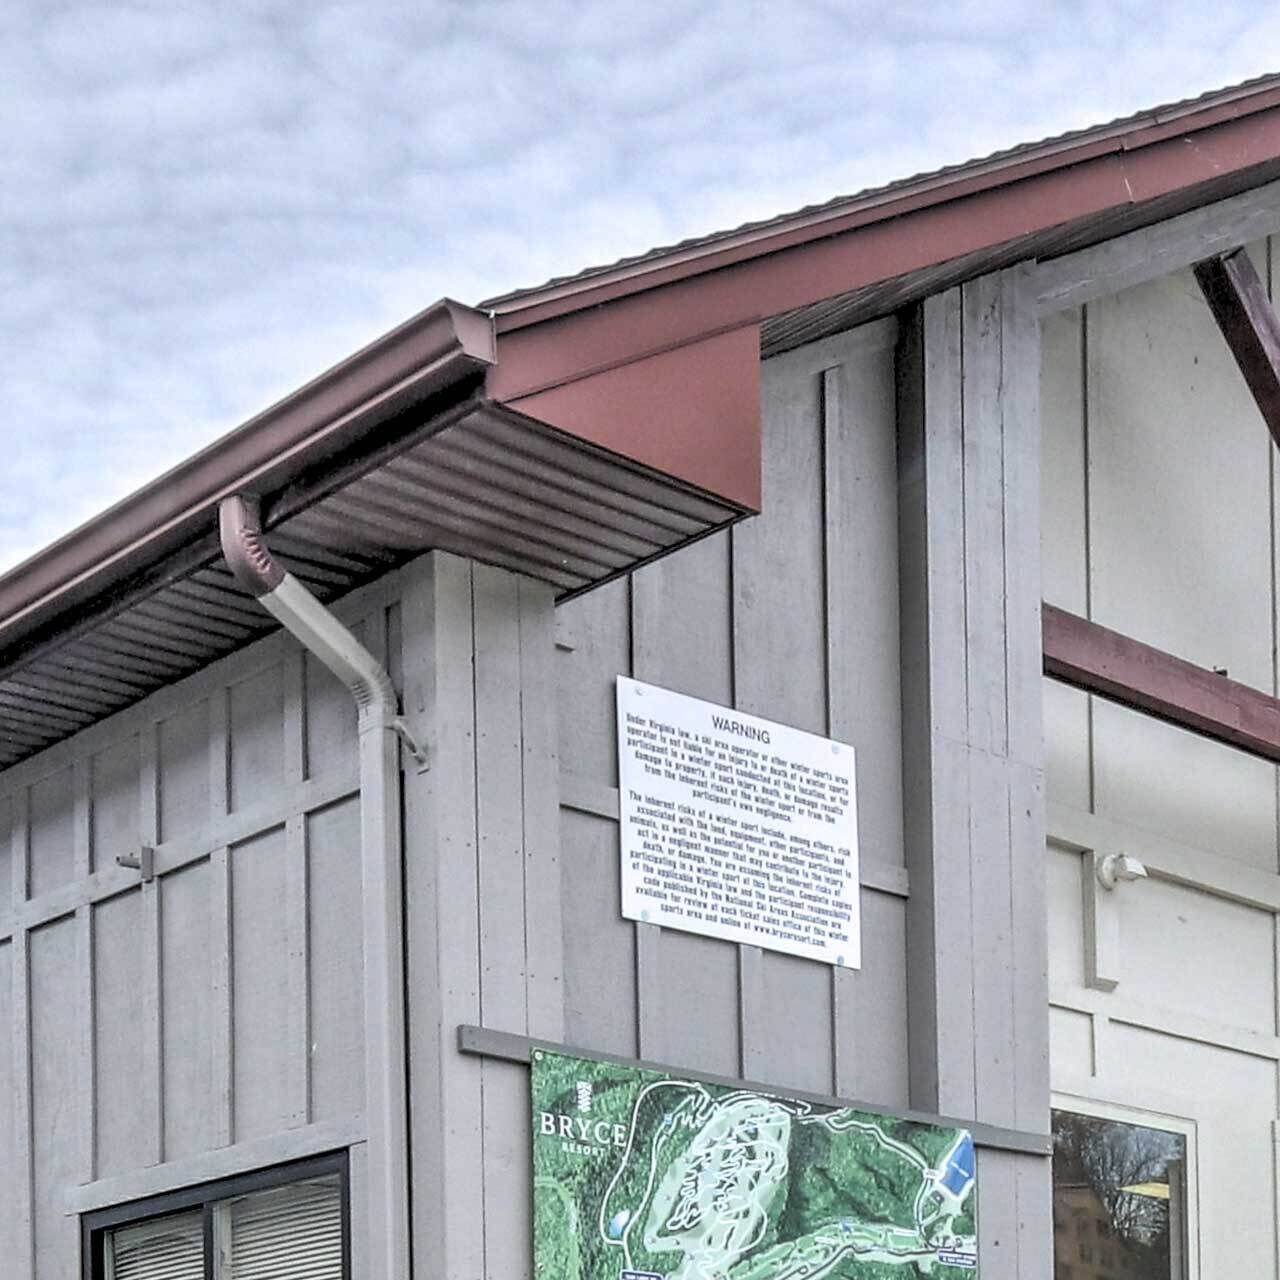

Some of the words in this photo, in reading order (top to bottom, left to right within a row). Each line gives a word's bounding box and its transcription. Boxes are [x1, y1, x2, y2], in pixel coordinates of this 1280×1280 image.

[712, 715, 771, 744] WARNING
[540, 1111, 627, 1147] BRYCE
[562, 1142, 606, 1156] RESORT
